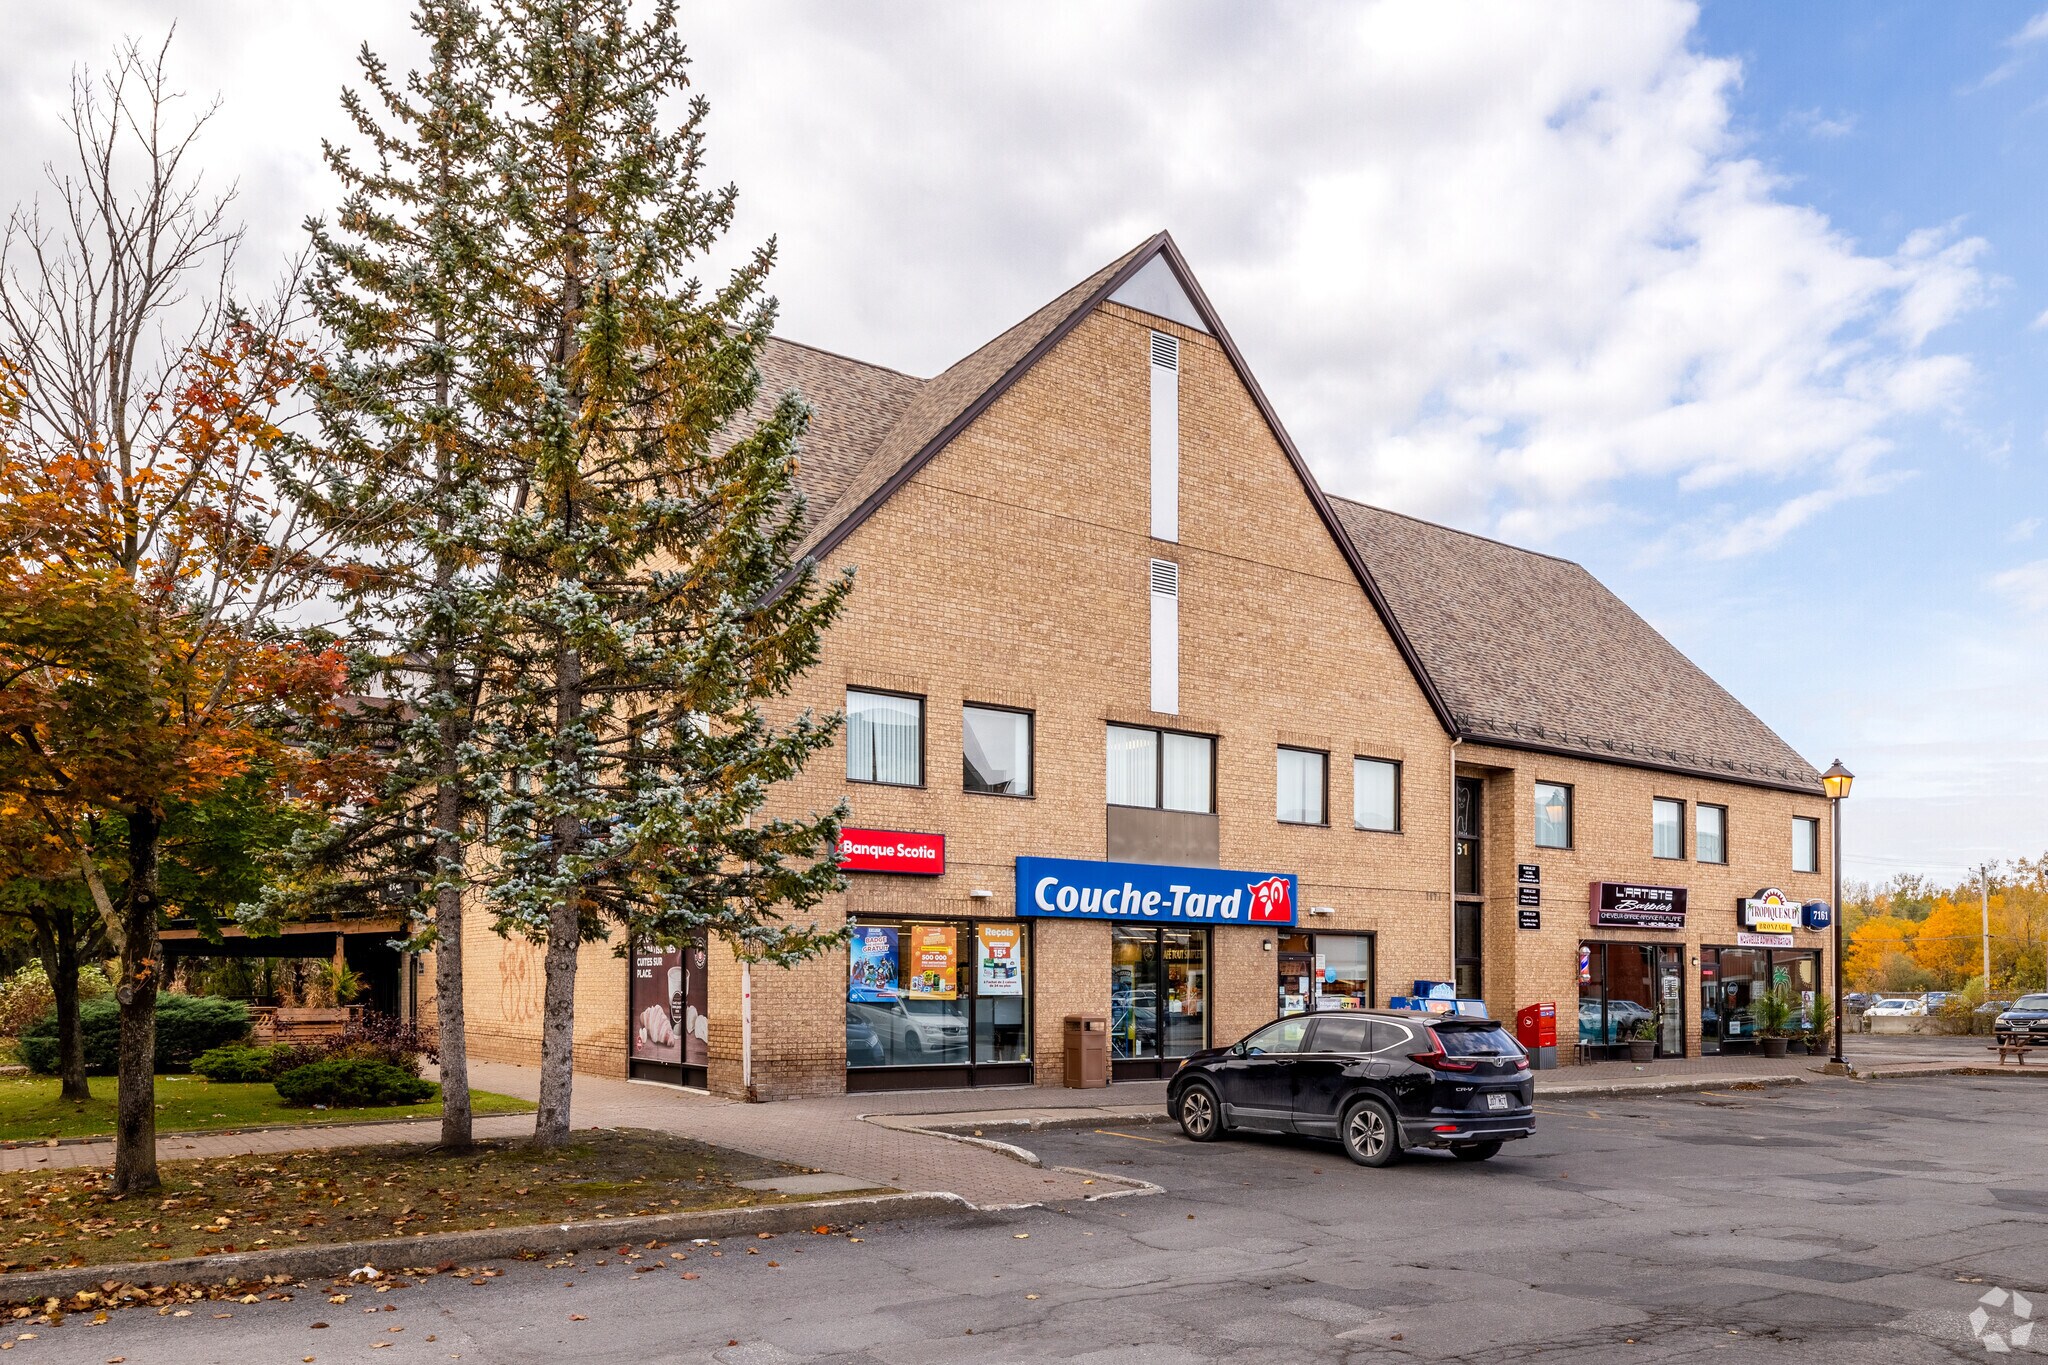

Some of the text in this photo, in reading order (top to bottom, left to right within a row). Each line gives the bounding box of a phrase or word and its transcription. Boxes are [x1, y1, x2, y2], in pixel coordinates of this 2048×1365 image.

[843, 840, 935, 859] Banque Scotia
[1034, 876, 1242, 919] Couche-Tard
[1616, 887, 1673, 900] L'ARTISTE
[1615, 899, 1672, 912] Barbier
[1751, 906, 1797, 921] TROPIQUE SUD
[1813, 911, 1828, 920] 7161
[985, 927, 1014, 938] Reçois
[1759, 923, 1788, 931] BRONZAGE
[865, 936, 887, 944] BADGE
[637, 957, 663, 966] CUITES SUR
